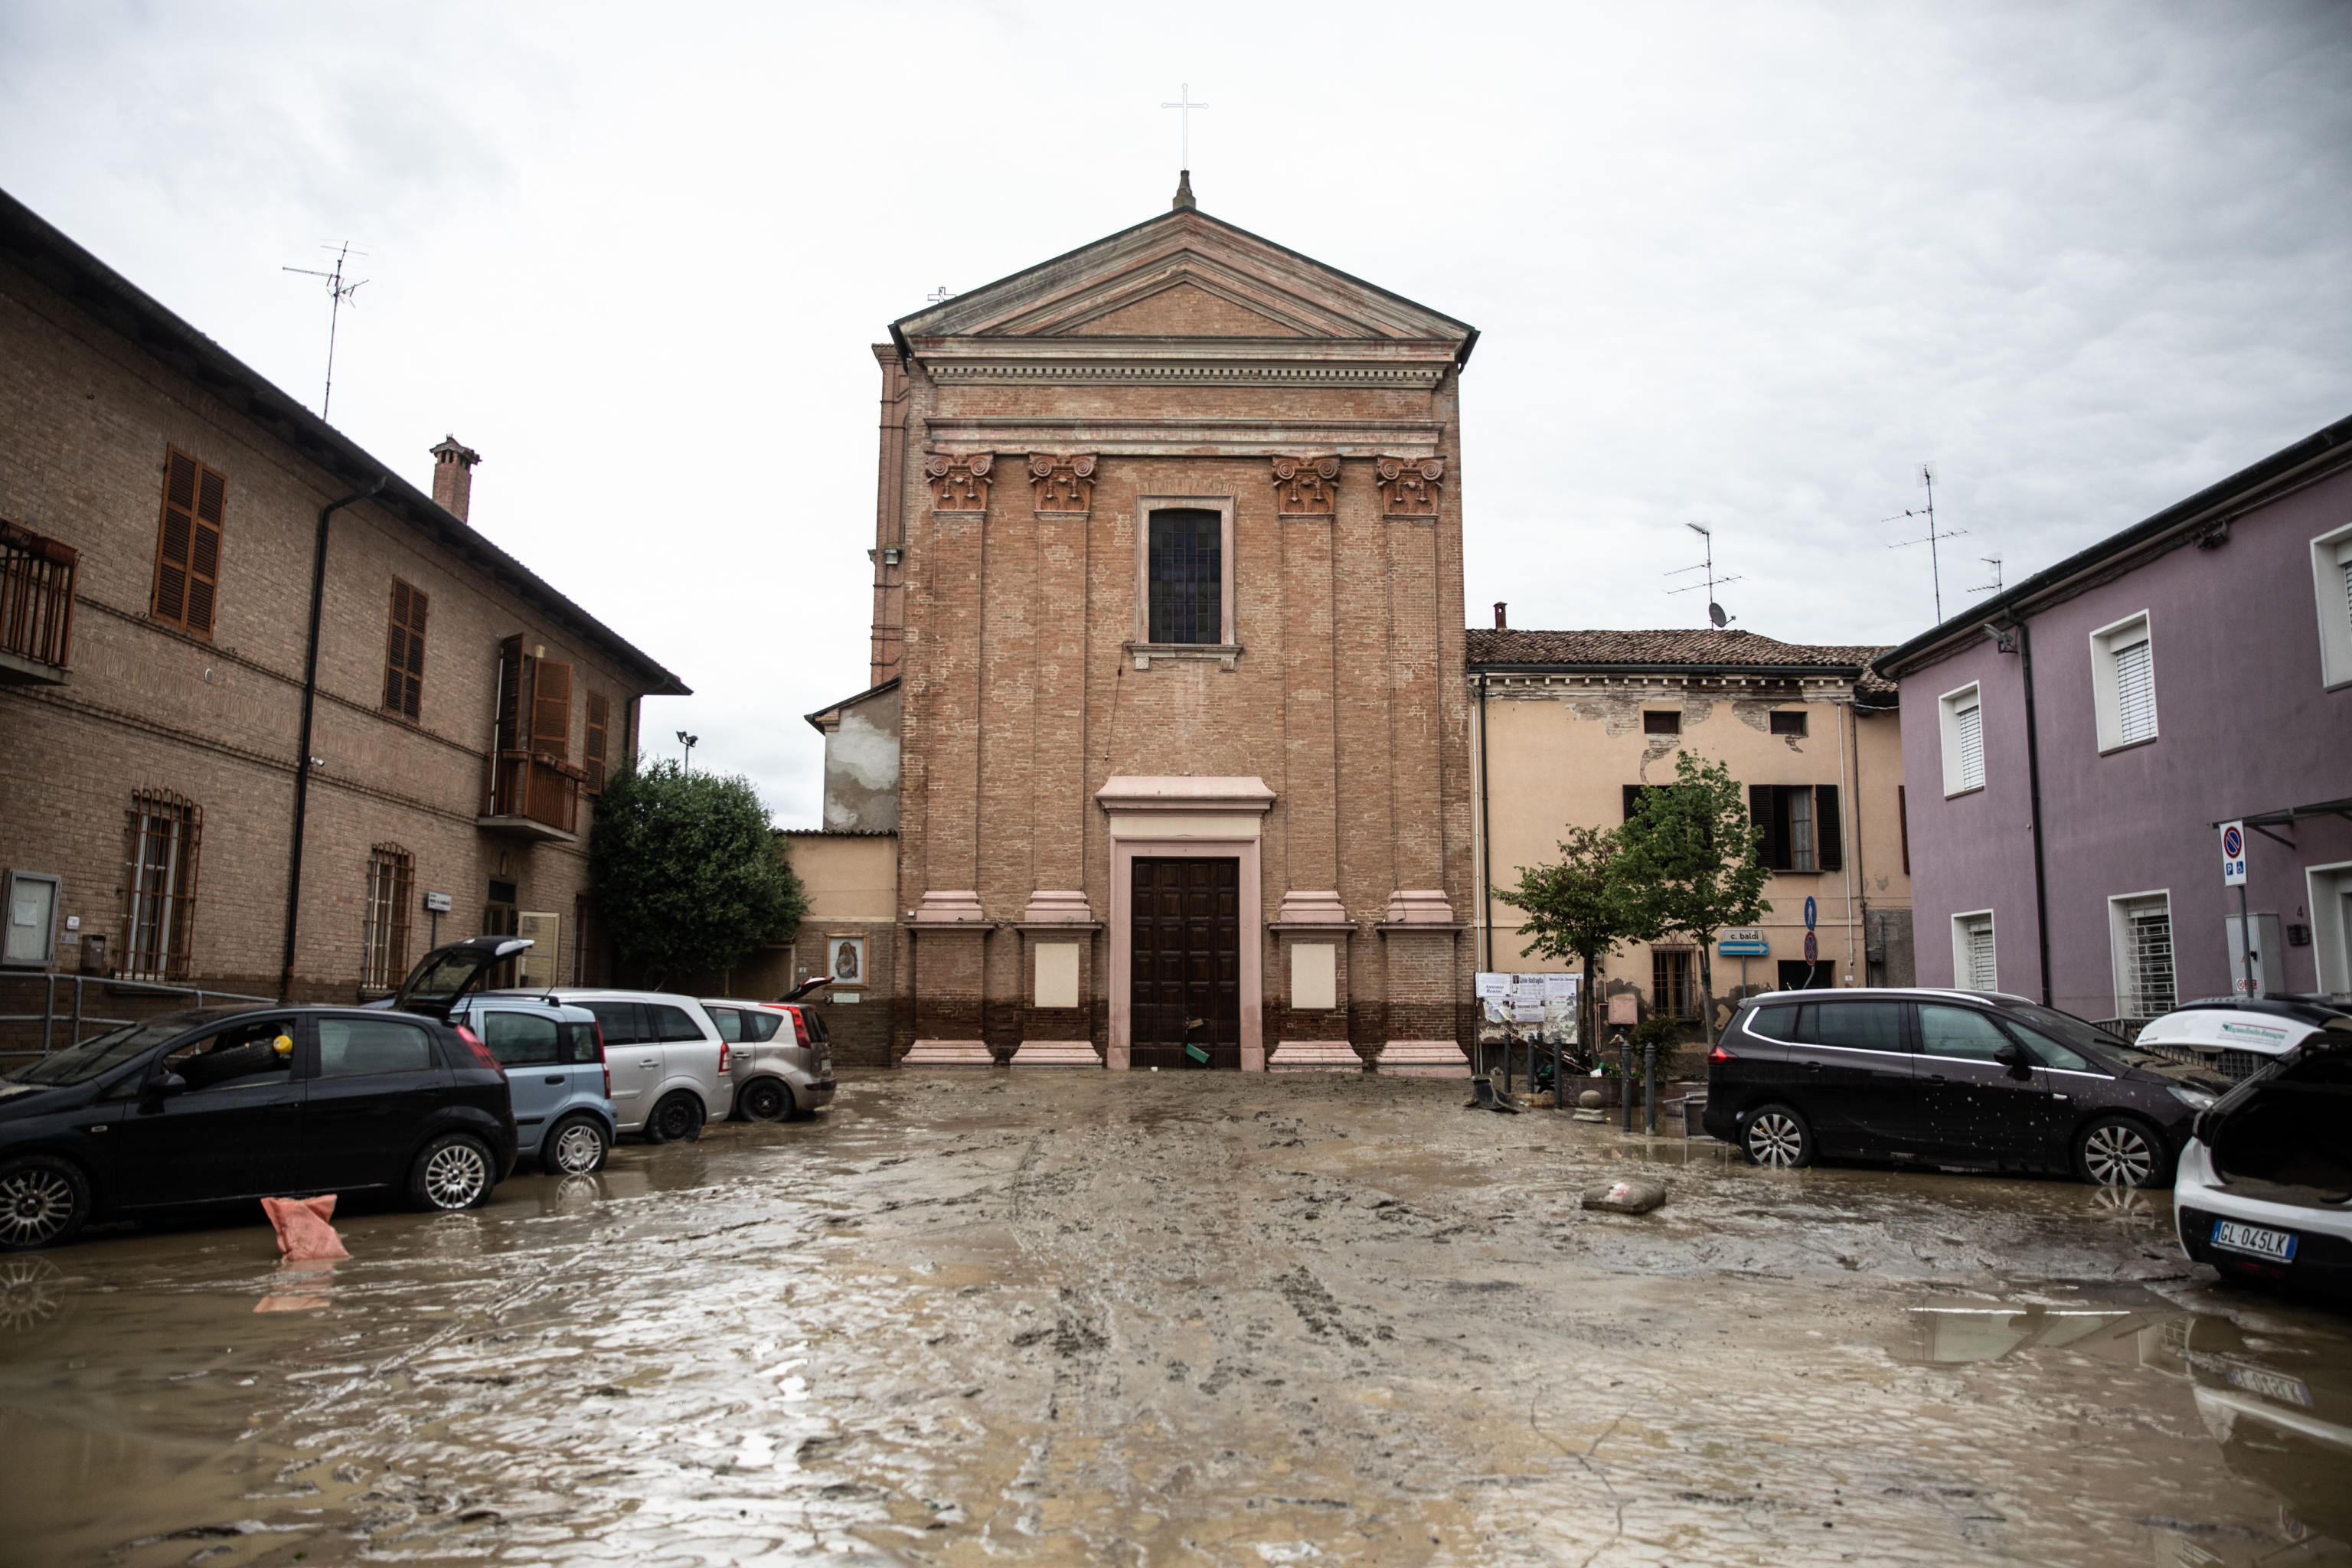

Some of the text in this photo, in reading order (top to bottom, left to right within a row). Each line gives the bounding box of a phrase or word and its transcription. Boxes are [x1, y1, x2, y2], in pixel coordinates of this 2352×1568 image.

[2227, 864, 2232, 874] P
[2297, 906, 2303, 918] 4
[2220, 1223, 2235, 1243] GL
[2240, 1228, 2286, 1254] 045LK
